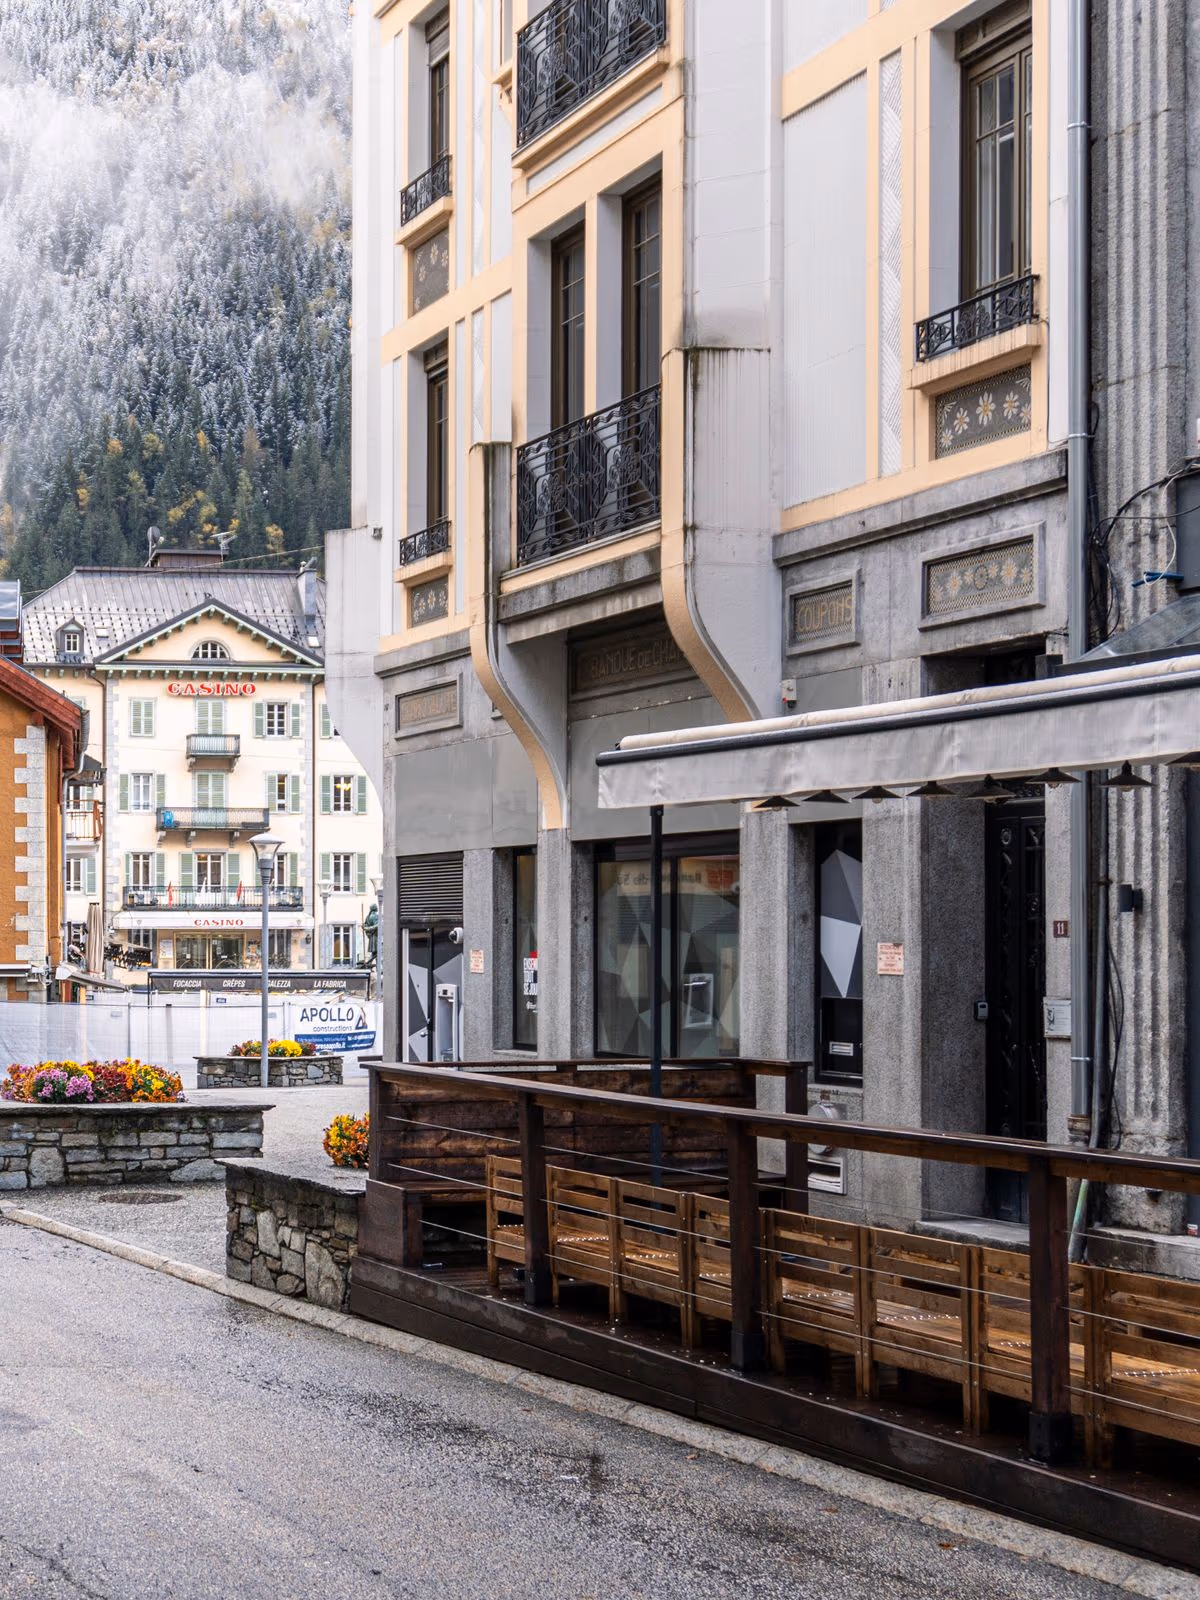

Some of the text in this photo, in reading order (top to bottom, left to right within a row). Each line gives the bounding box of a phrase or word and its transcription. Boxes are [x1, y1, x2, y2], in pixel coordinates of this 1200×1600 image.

[167, 682, 257, 695] CASINO
[1056, 922, 1065, 935] 11
[173, 979, 202, 988] FOCACCIA
[222, 978, 246, 988] CRÊPES
[313, 979, 322, 988] LA
[322, 979, 347, 988] FABRICA
[299, 1007, 354, 1022] APOLLO
